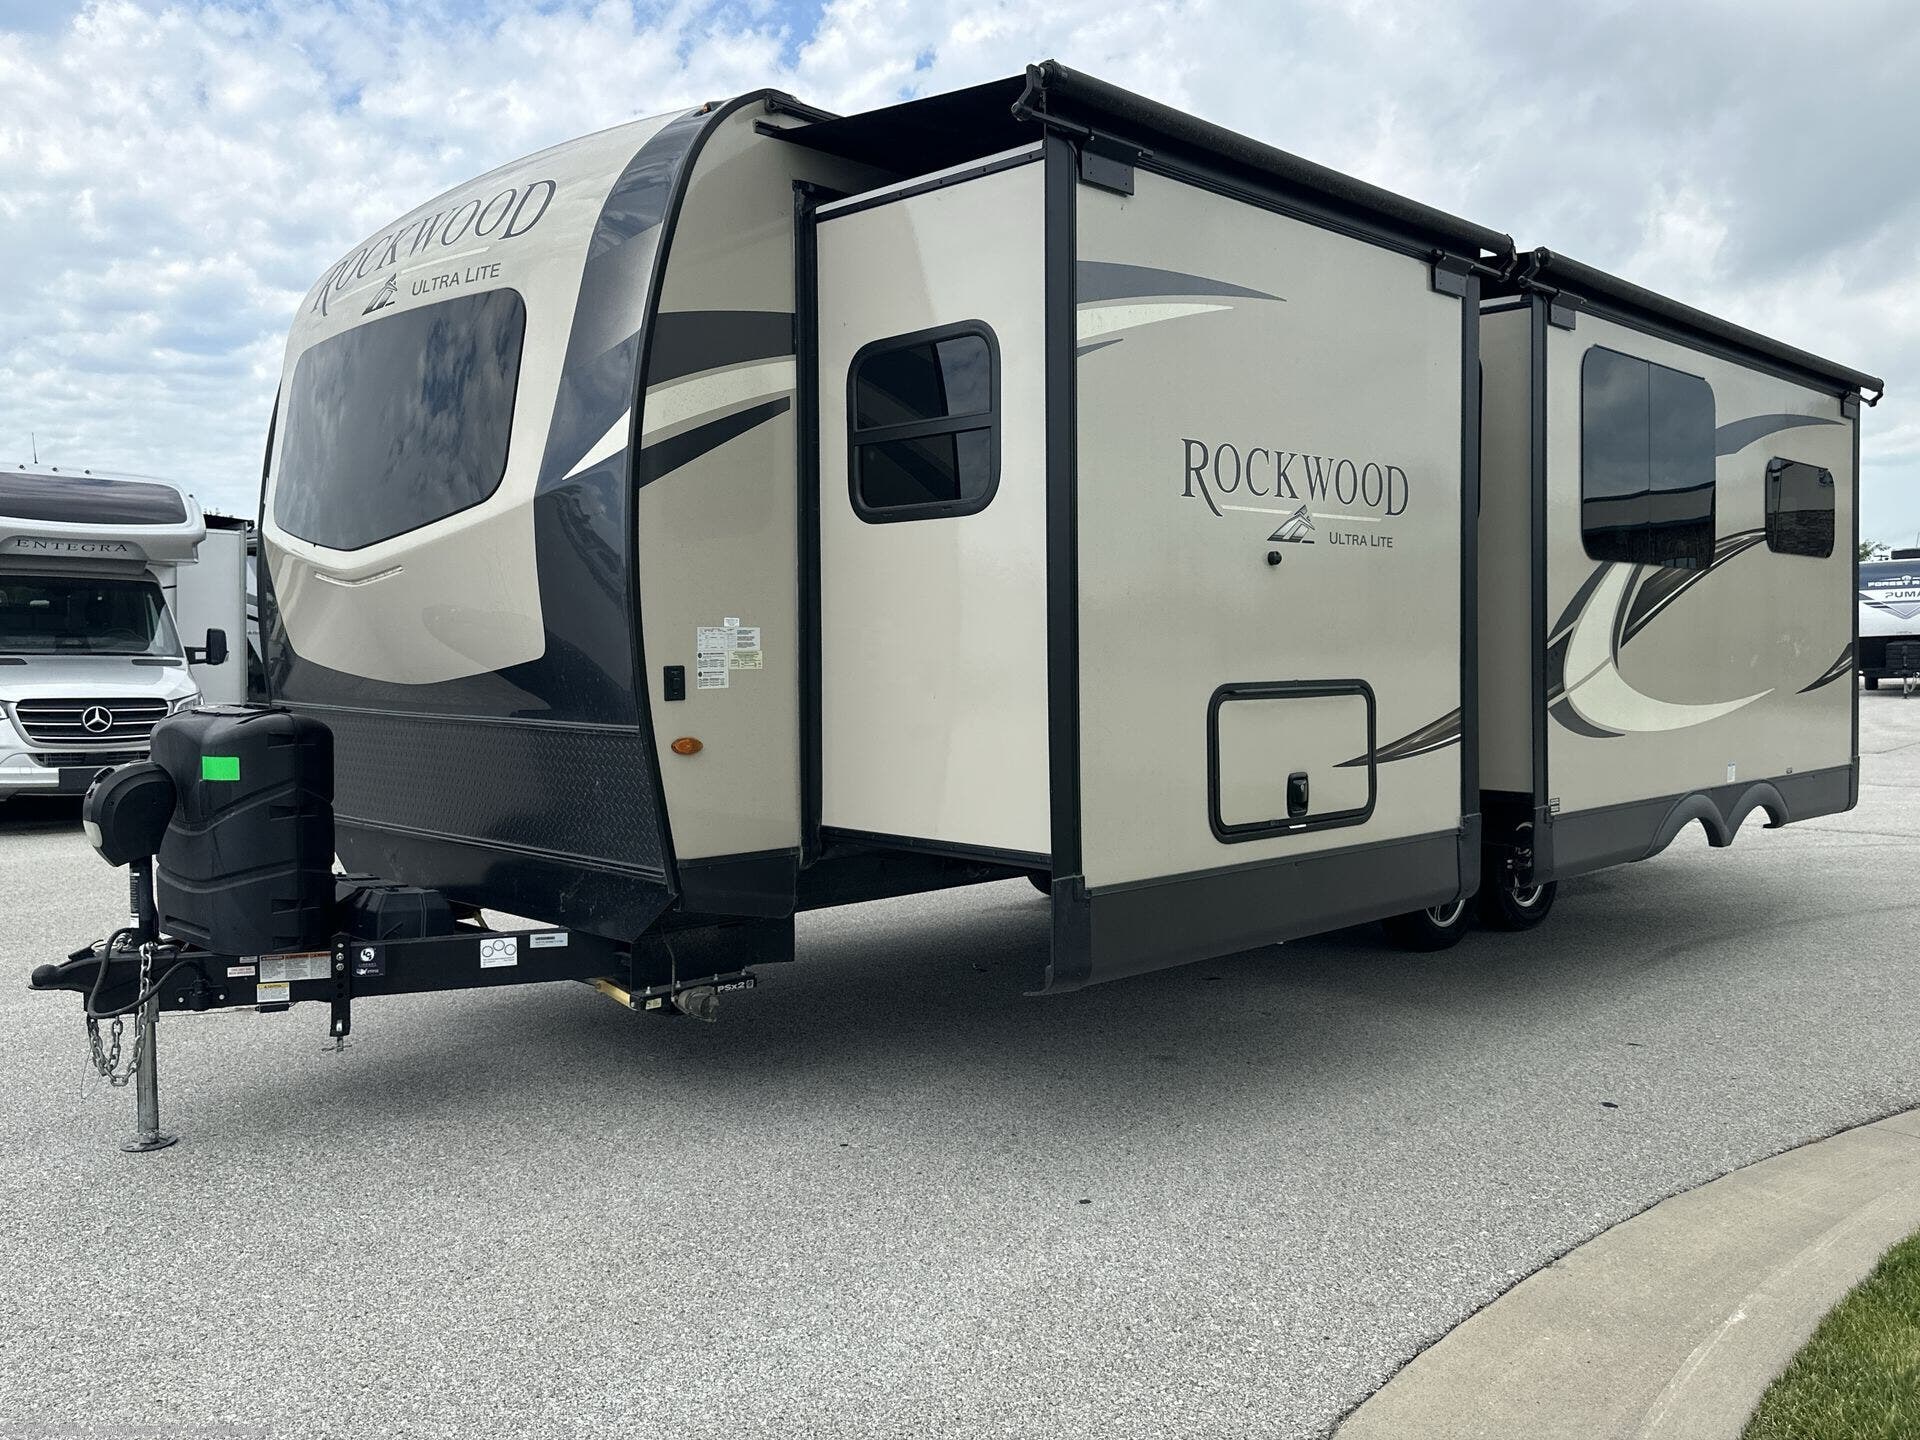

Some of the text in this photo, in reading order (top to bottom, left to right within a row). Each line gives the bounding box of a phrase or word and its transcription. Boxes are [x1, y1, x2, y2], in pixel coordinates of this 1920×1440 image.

[310, 180, 557, 317] ROCKWOOD
[411, 262, 501, 296] ULTRA LITE
[1181, 438, 1409, 517] ROCKWOOD
[16, 539, 128, 552] ENTEGRA
[1329, 531, 1394, 548] ULTRA LITE
